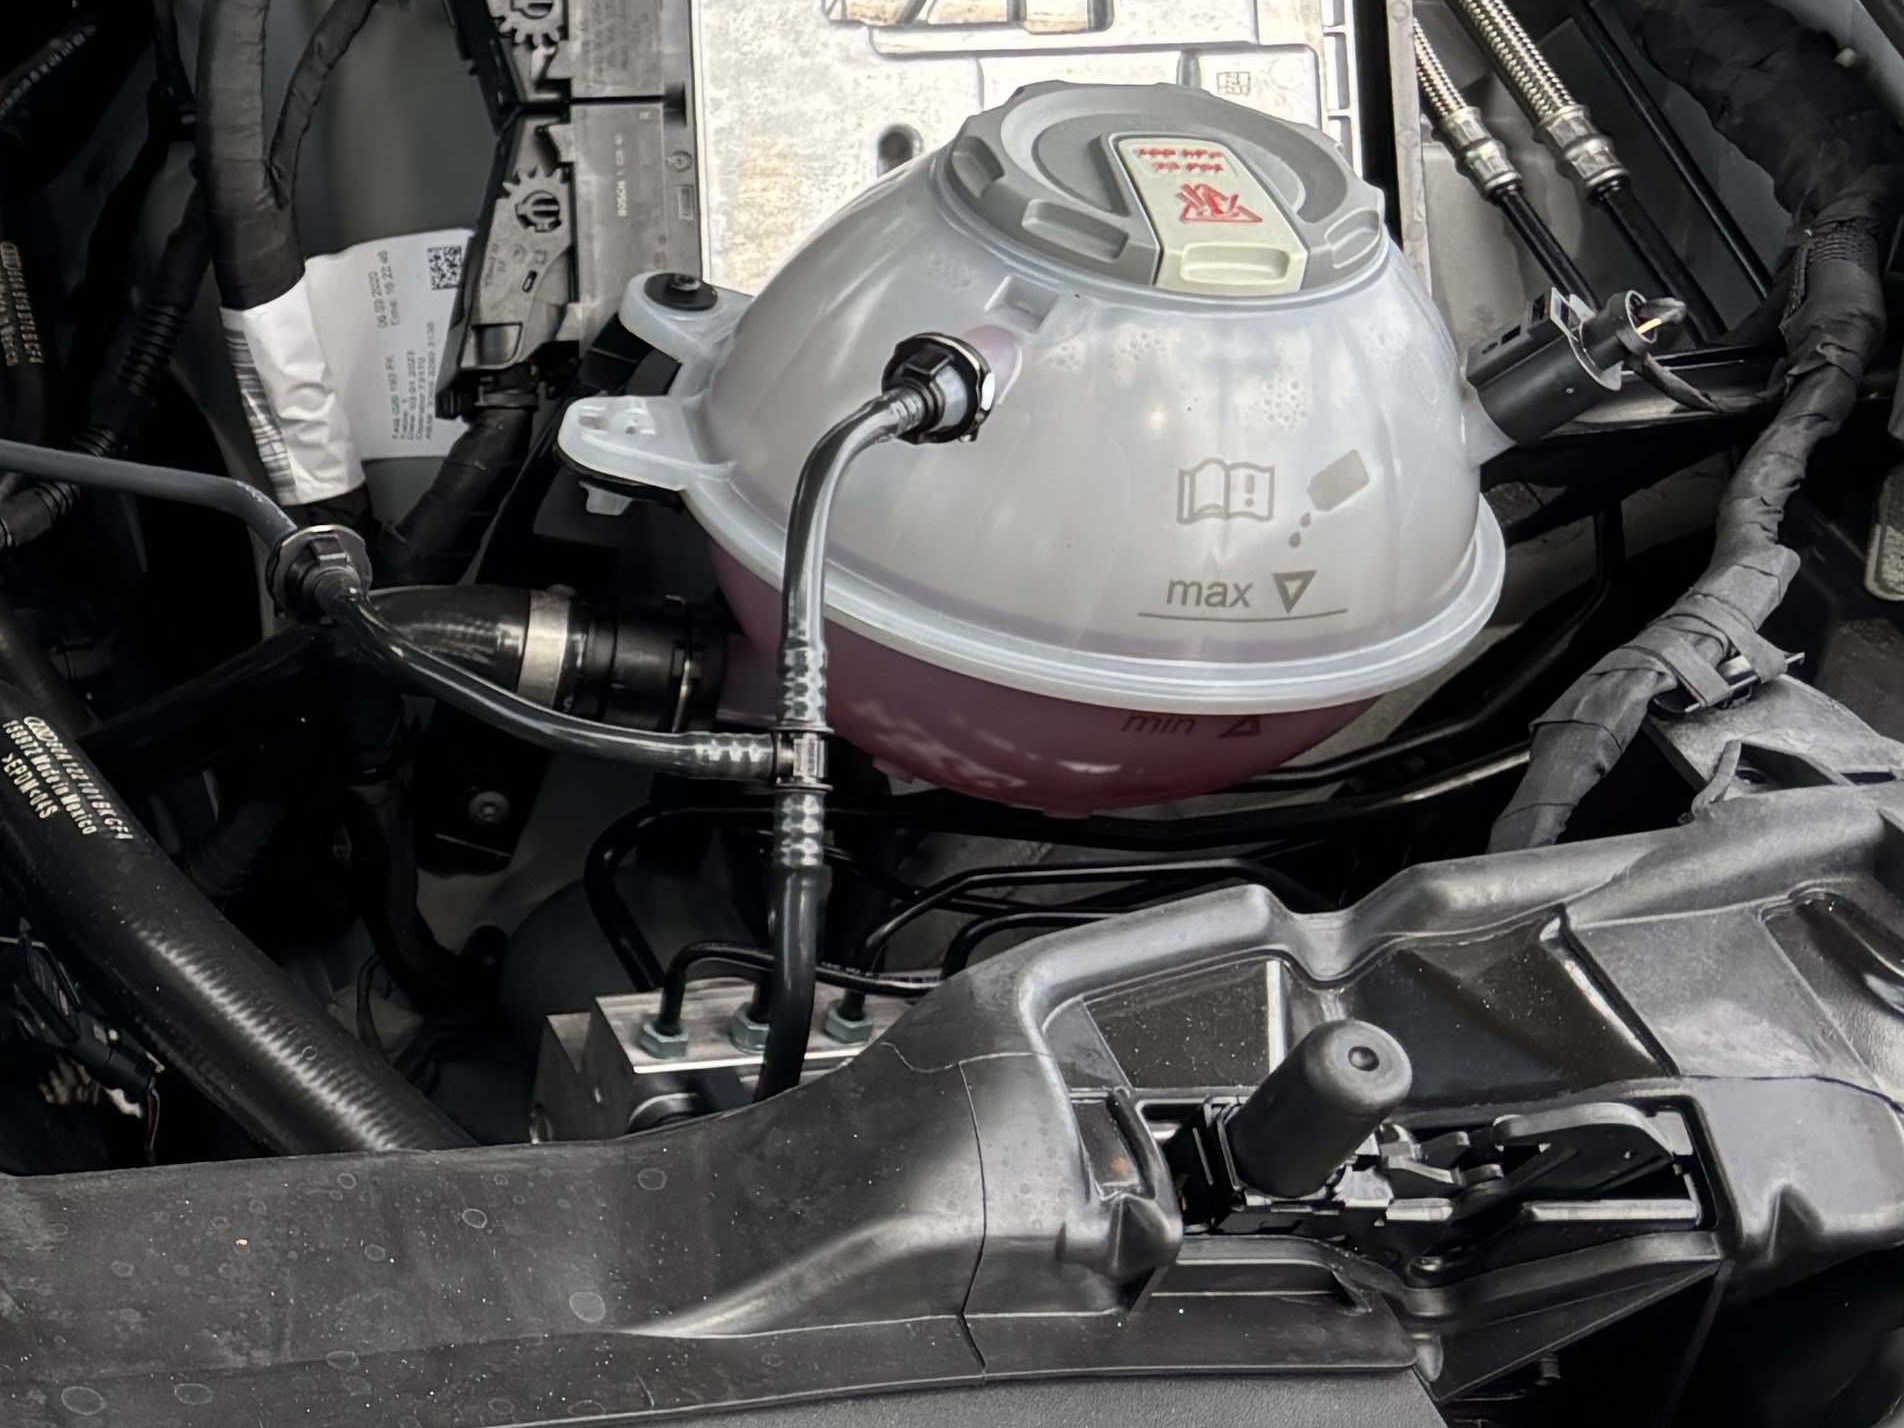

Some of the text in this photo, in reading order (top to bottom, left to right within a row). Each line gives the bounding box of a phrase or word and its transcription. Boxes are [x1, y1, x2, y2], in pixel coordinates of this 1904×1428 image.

[1165, 575, 1252, 608] max
[1120, 711, 1197, 738] min
[31, 754, 97, 834] Made in Mexico
